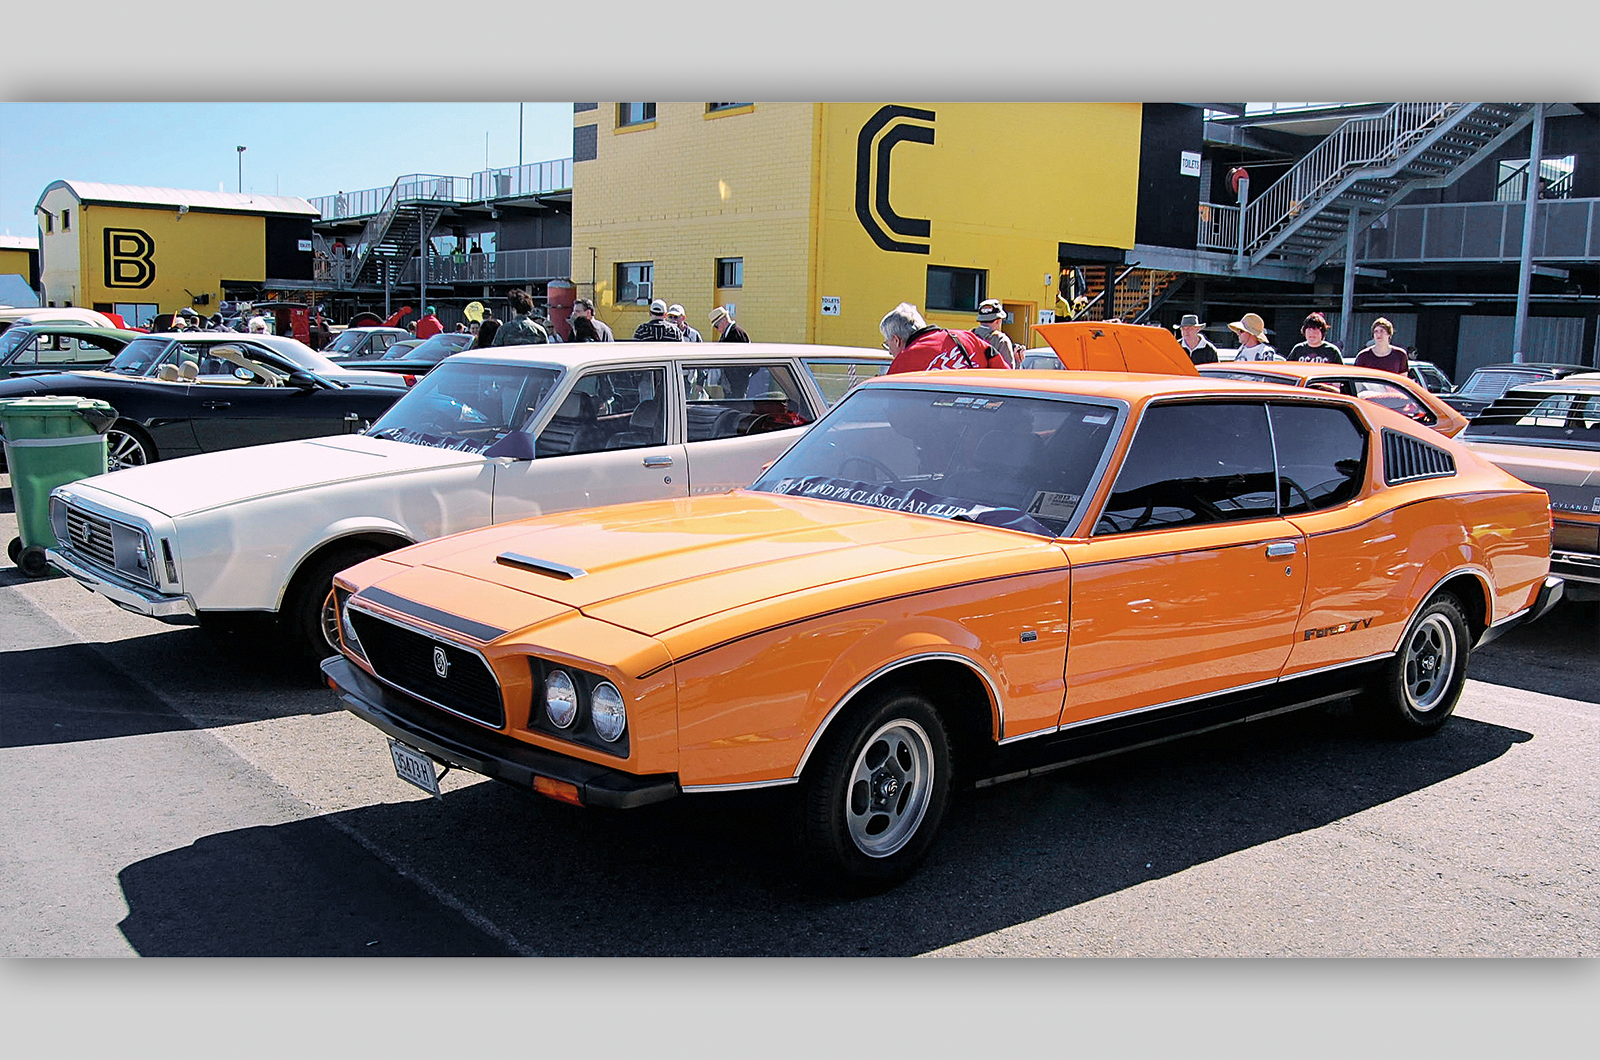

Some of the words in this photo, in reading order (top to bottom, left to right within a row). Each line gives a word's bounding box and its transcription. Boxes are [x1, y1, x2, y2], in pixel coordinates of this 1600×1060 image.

[1182, 158, 1200, 169] TOILETS
[855, 104, 936, 255] C
[103, 227, 156, 289] B
[851, 490, 900, 509] CLASSIC
[1552, 502, 1588, 510] EYLAND
